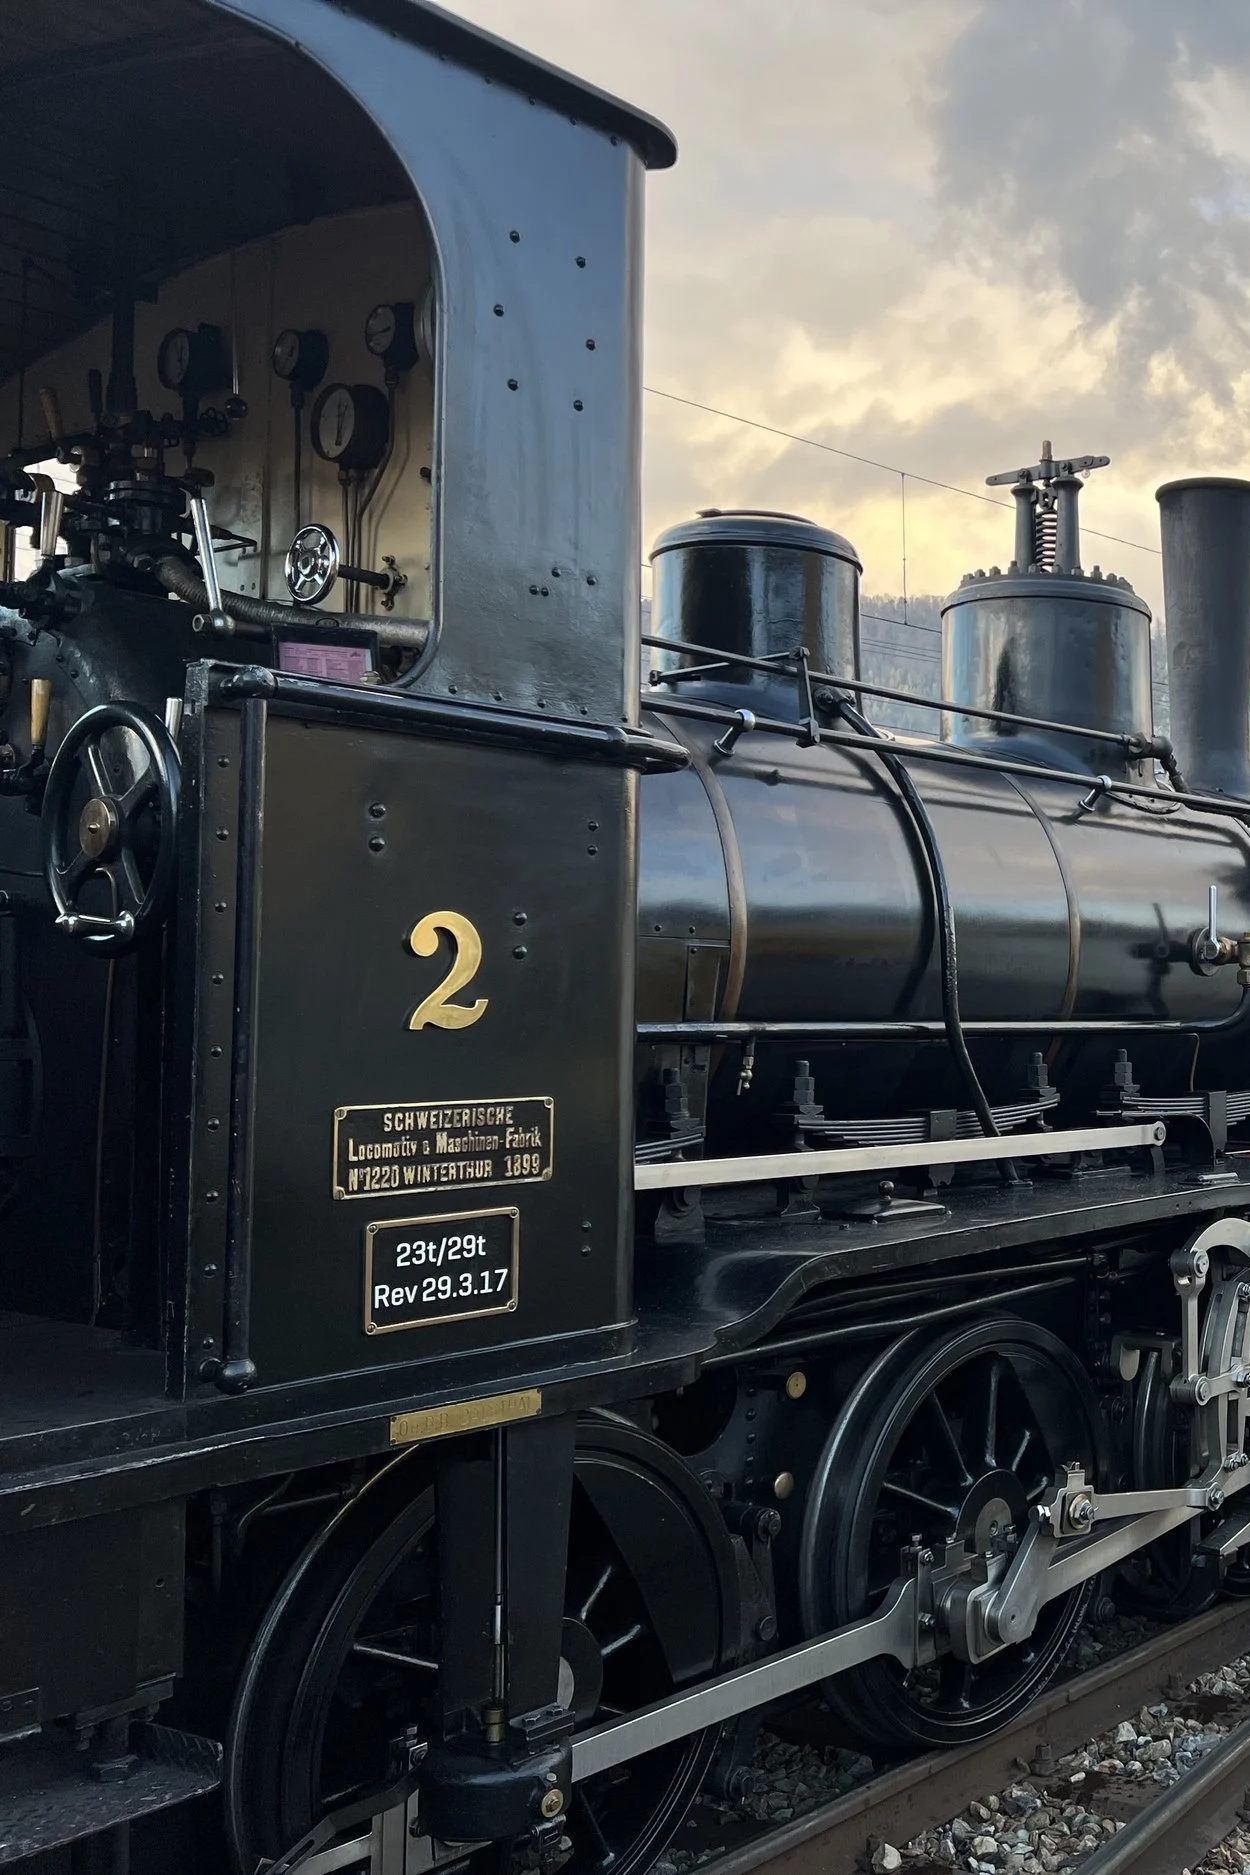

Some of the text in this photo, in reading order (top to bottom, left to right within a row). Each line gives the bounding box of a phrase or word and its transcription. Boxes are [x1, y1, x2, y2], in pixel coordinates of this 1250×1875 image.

[410, 911, 488, 1030] 2
[383, 1106, 514, 1132] SCHWEIZERISCHE
[348, 1136, 417, 1161] Locomotiv
[403, 1160, 493, 1185] WINTERTHUR
[504, 1153, 540, 1178] 1899
[396, 1235, 486, 1267] 23t/29t
[374, 1268, 509, 1309] Rev 29.3.17
